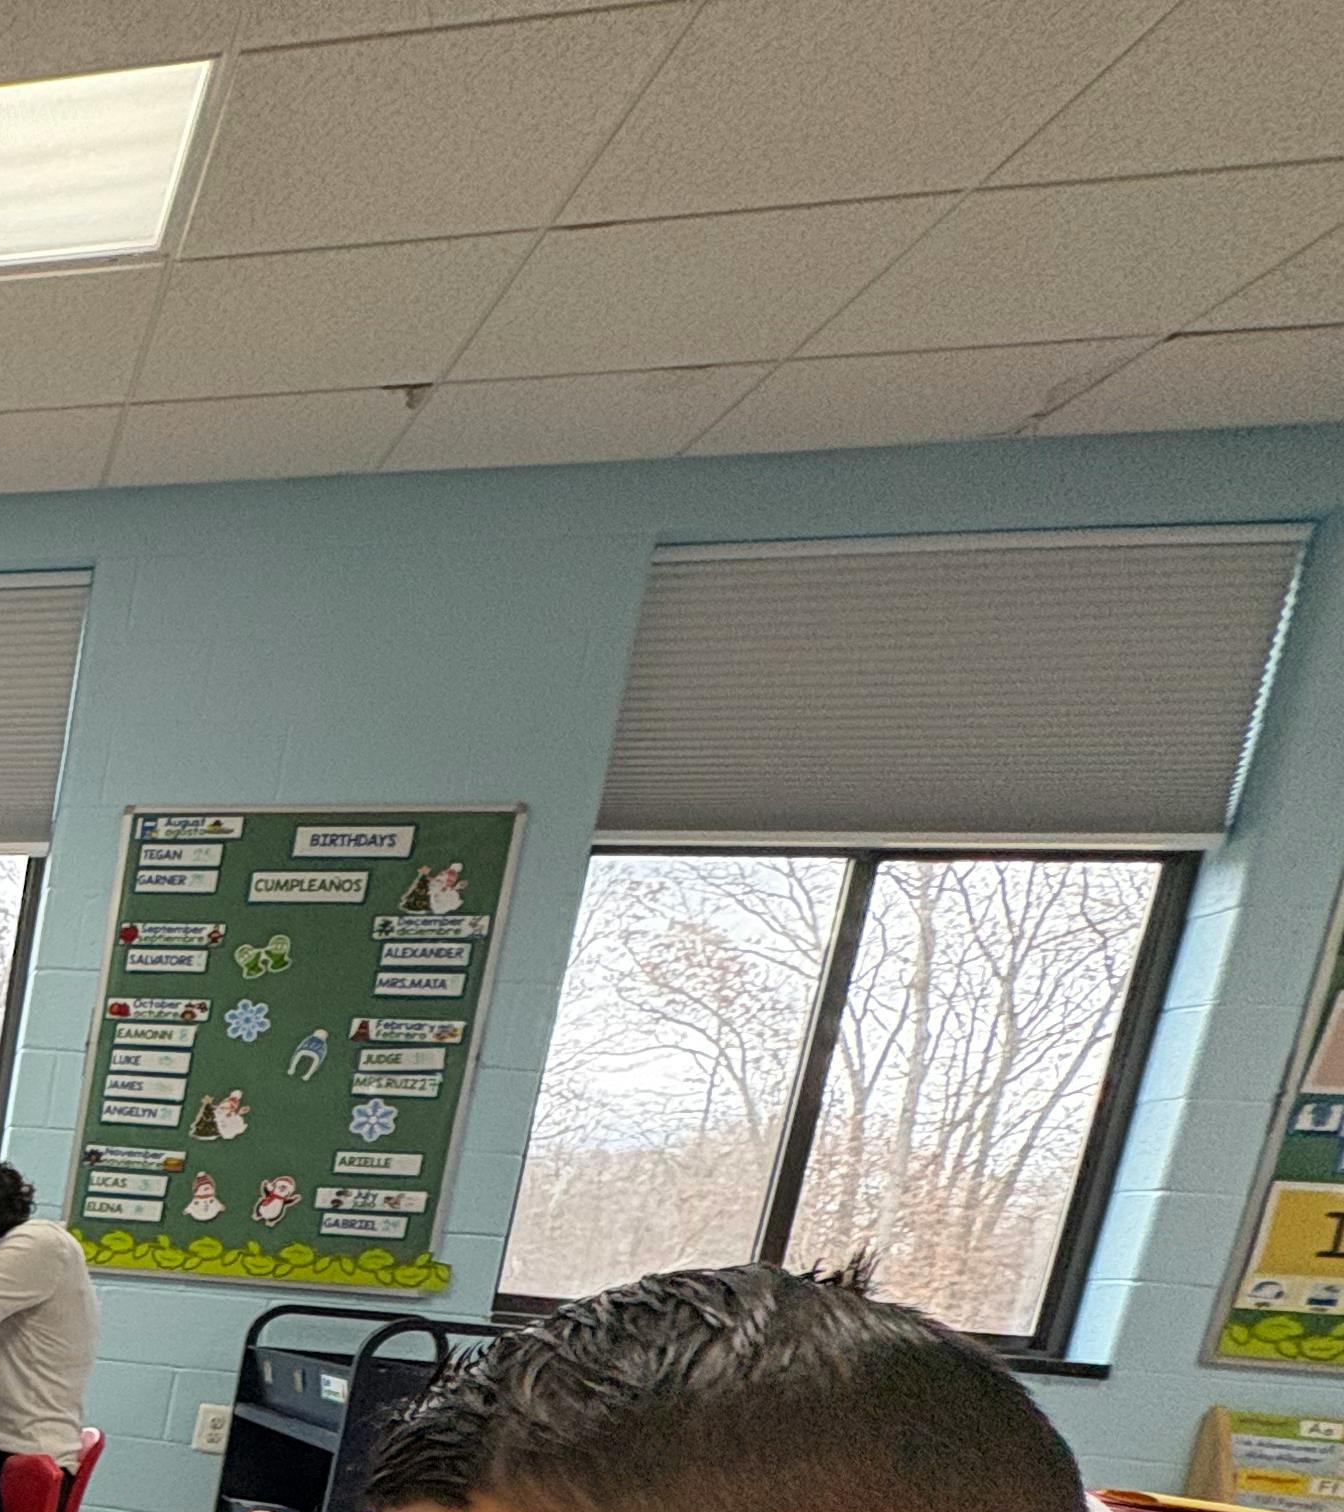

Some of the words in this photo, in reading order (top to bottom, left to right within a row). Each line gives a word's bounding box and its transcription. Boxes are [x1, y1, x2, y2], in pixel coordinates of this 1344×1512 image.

[310, 833, 397, 847] BIRTHDAYS
[143, 849, 182, 860] TEGAN
[138, 875, 187, 885] GARNER
[254, 877, 363, 892] CUMPLEAÑOS
[398, 917, 464, 926] December
[142, 924, 207, 935] September
[384, 947, 464, 958] ALEXANDER
[129, 954, 194, 966] SALVATORE
[133, 999, 182, 1009] October
[375, 1019, 436, 1032] February
[117, 1028, 173, 1040] EAMONN
[375, 1031, 427, 1039] febrero
[113, 1055, 142, 1065] LUKE
[363, 1053, 403, 1065] JUDGE
[108, 1081, 144, 1091] JAMES
[104, 1105, 158, 1118] ANGELYN
[105, 1149, 165, 1159] November
[339, 1156, 393, 1168] ARIELLE
[91, 1176, 128, 1188] LUCAS
[87, 1201, 122, 1213] ELENA
[324, 1217, 376, 1231] GABRIEL
